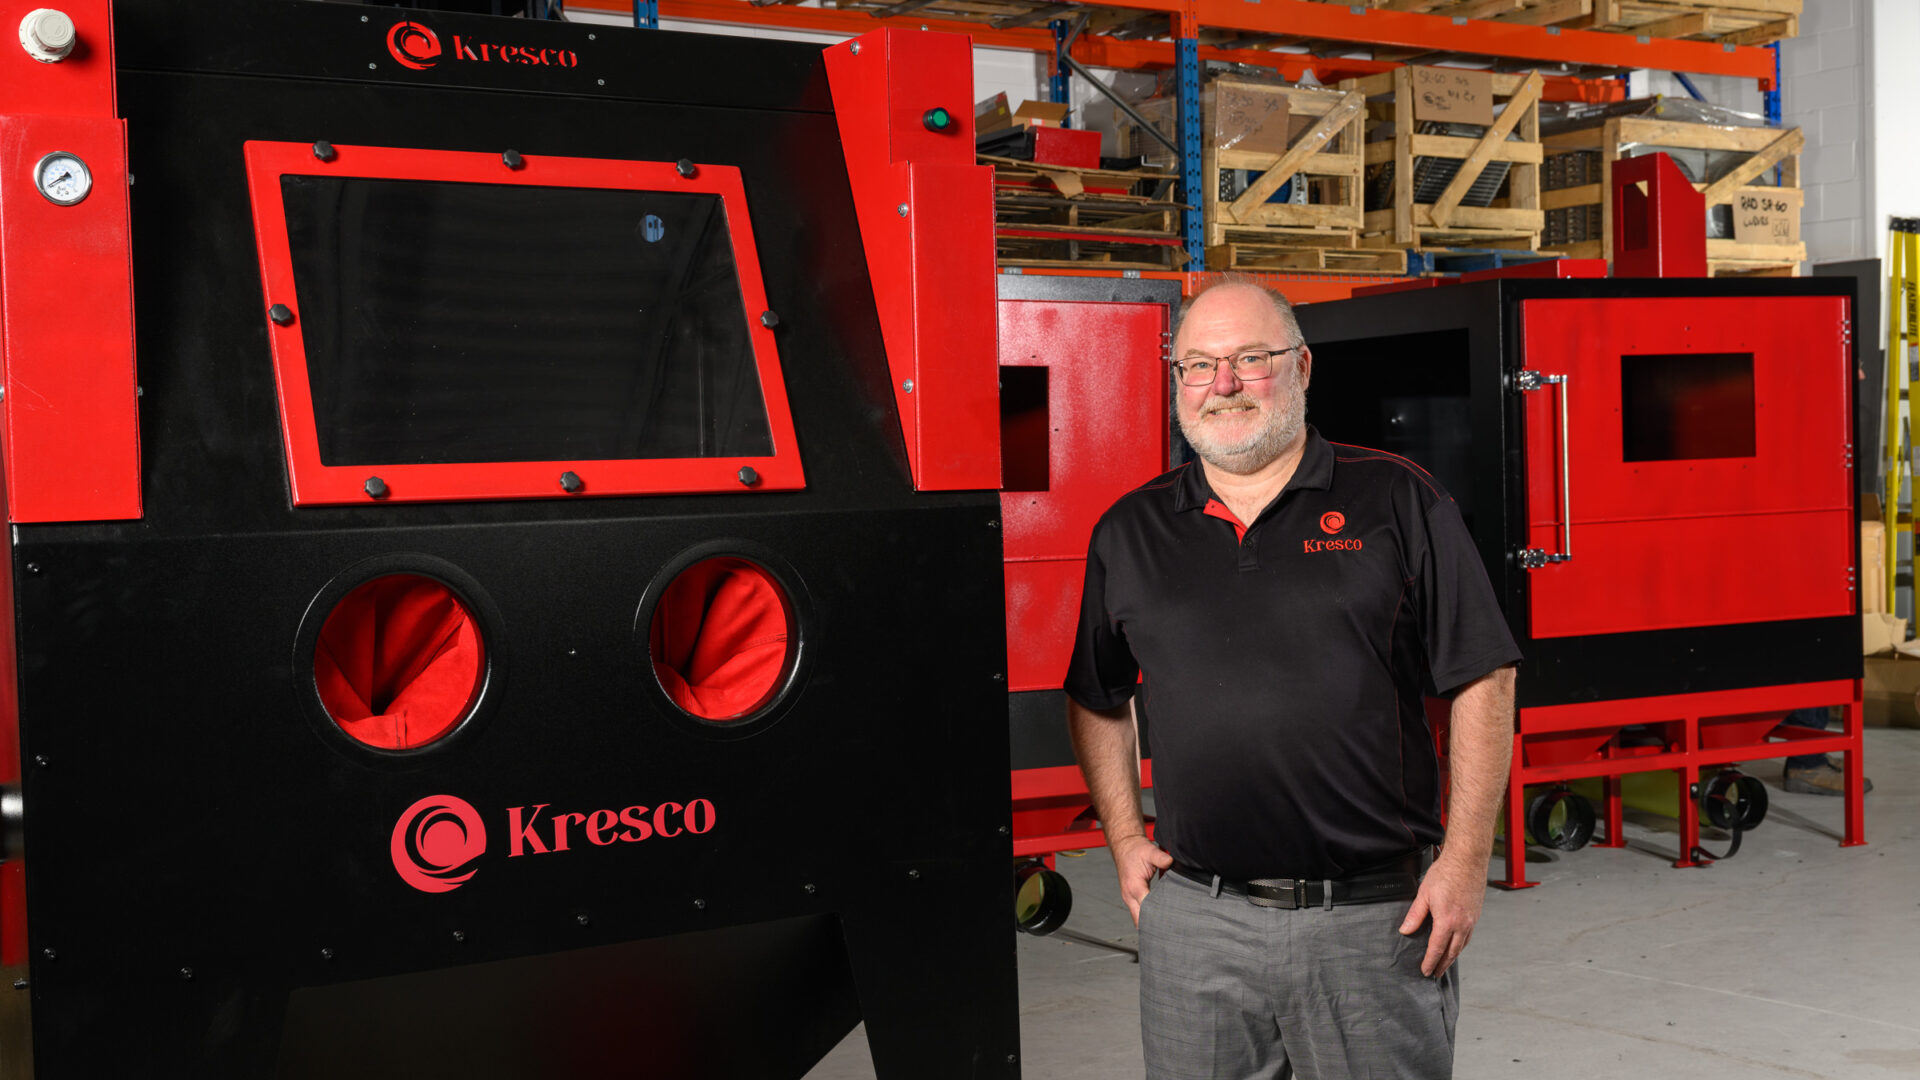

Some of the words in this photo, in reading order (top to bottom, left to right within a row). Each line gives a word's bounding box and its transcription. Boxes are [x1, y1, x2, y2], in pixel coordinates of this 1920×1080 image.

[453, 35, 578, 68] Kresco
[1303, 538, 1363, 554] Kresco
[506, 798, 717, 858] Kresco
